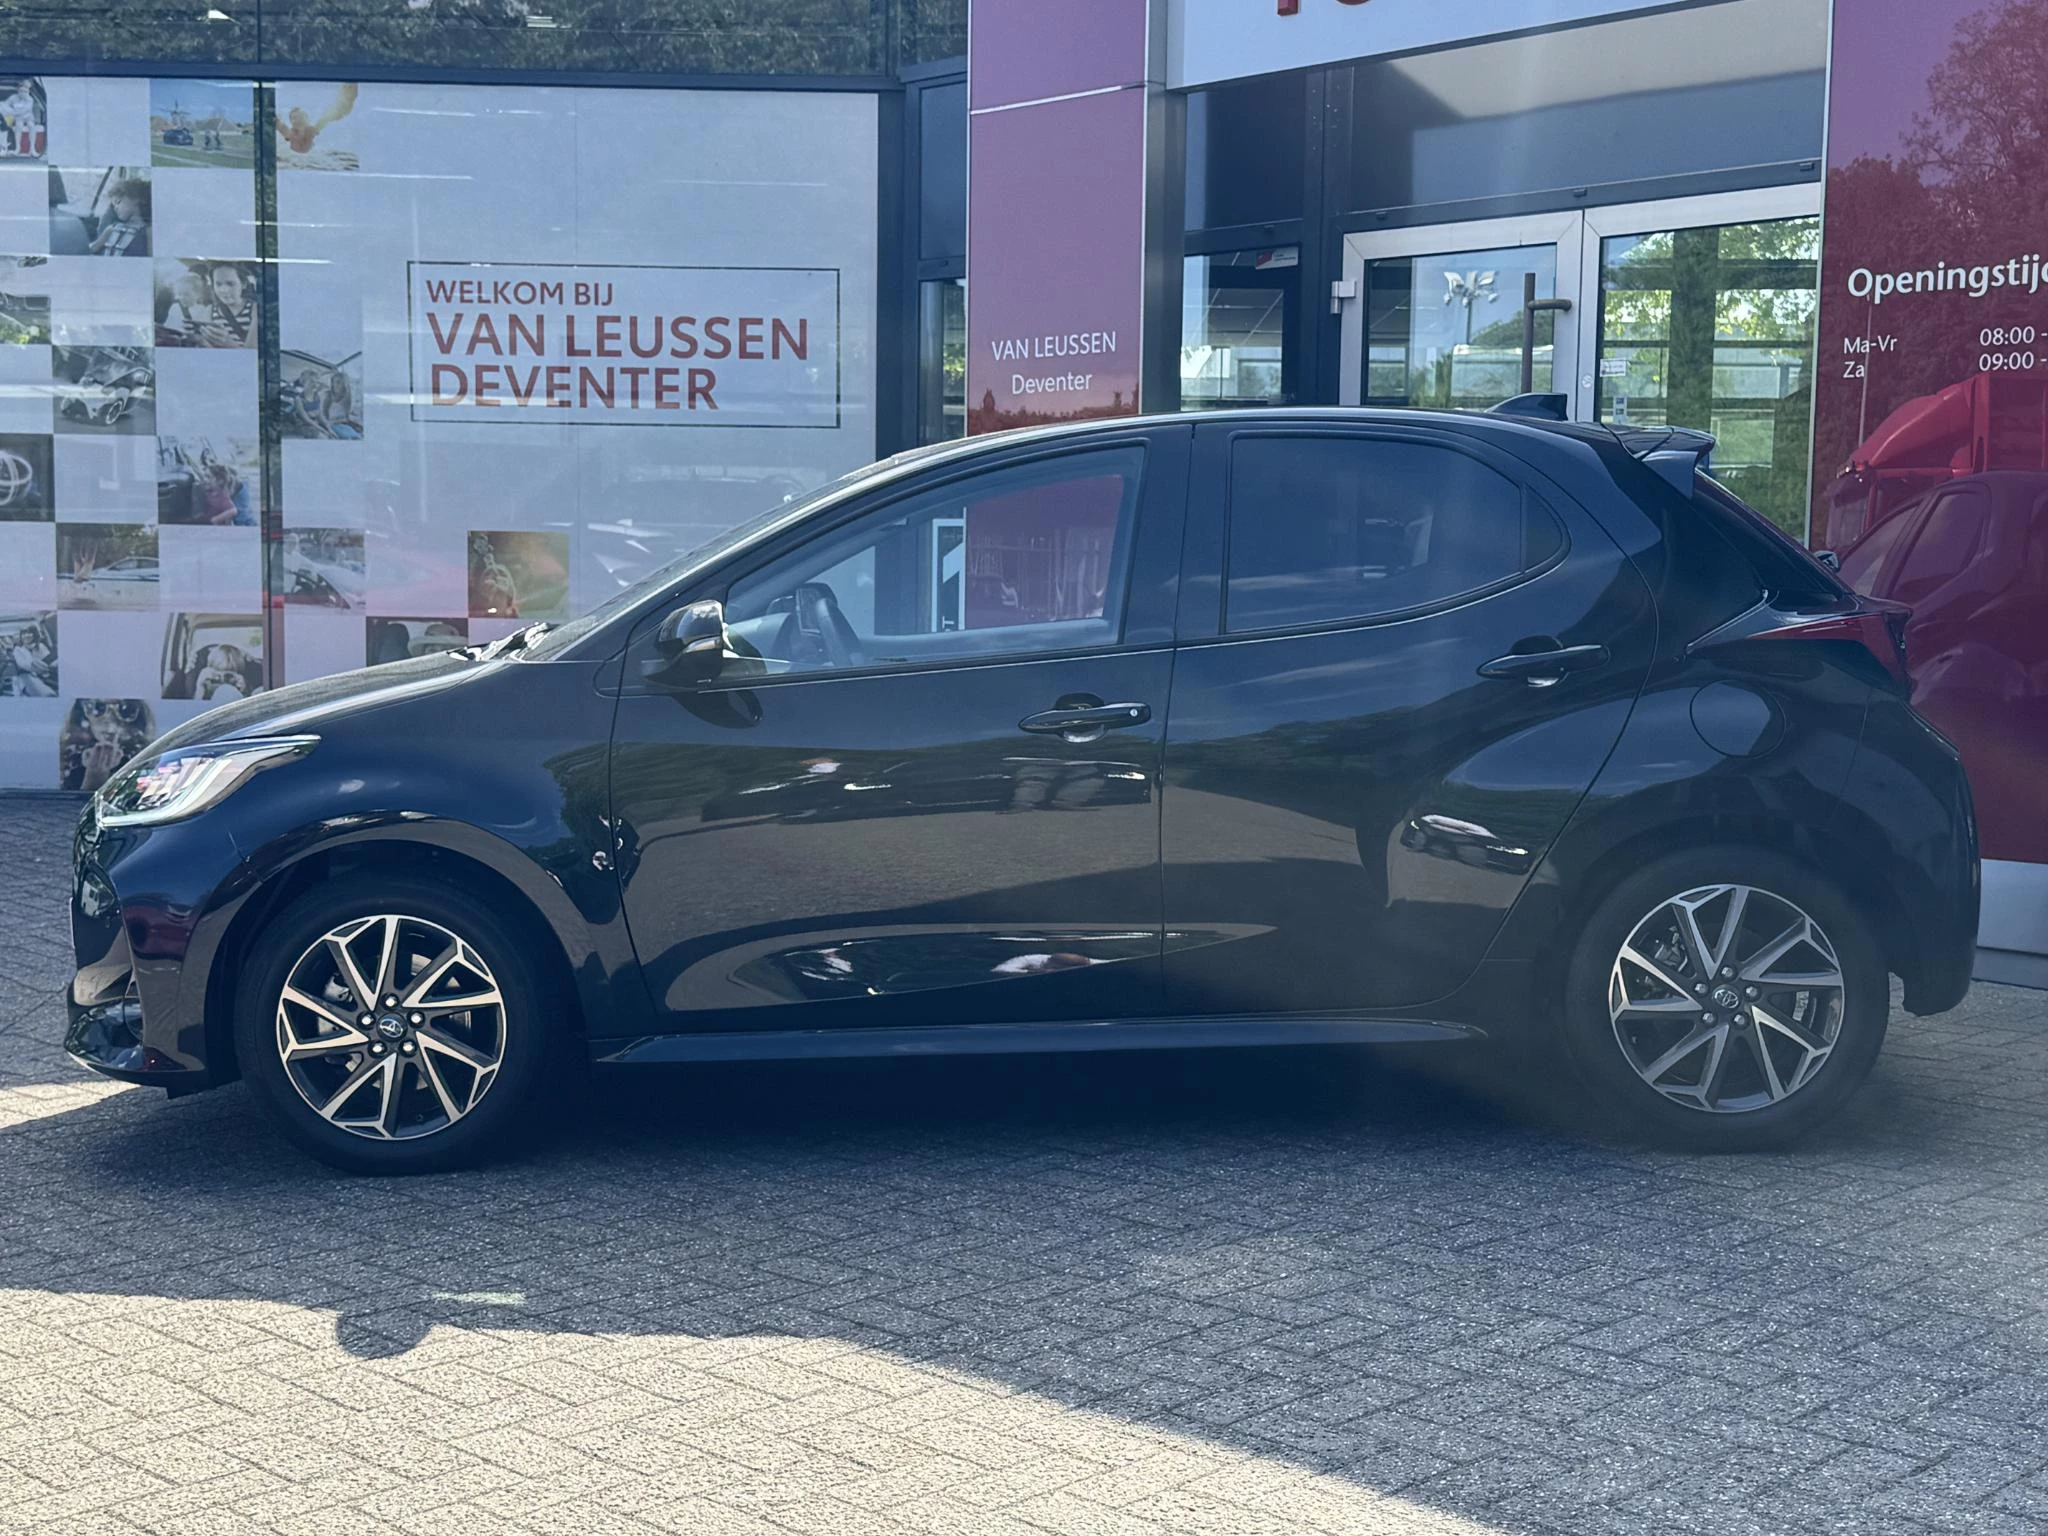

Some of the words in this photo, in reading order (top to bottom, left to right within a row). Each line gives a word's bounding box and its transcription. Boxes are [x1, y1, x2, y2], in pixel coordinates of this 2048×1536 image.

[425, 280, 564, 306] WELKOM
[574, 282, 614, 307] BIJ
[426, 312, 545, 357] VAN
[566, 314, 808, 361] LEUSSEN
[992, 338, 1029, 361] VAN
[1034, 330, 1116, 358] LEUSSEN
[1843, 334, 1898, 354] Ma-Vr
[1979, 326, 2035, 346] 08:00
[1843, 361, 1865, 378] Za
[1979, 351, 2034, 371] 09:00
[430, 363, 720, 411] DEVENTER
[1012, 371, 1092, 395] Deventer
